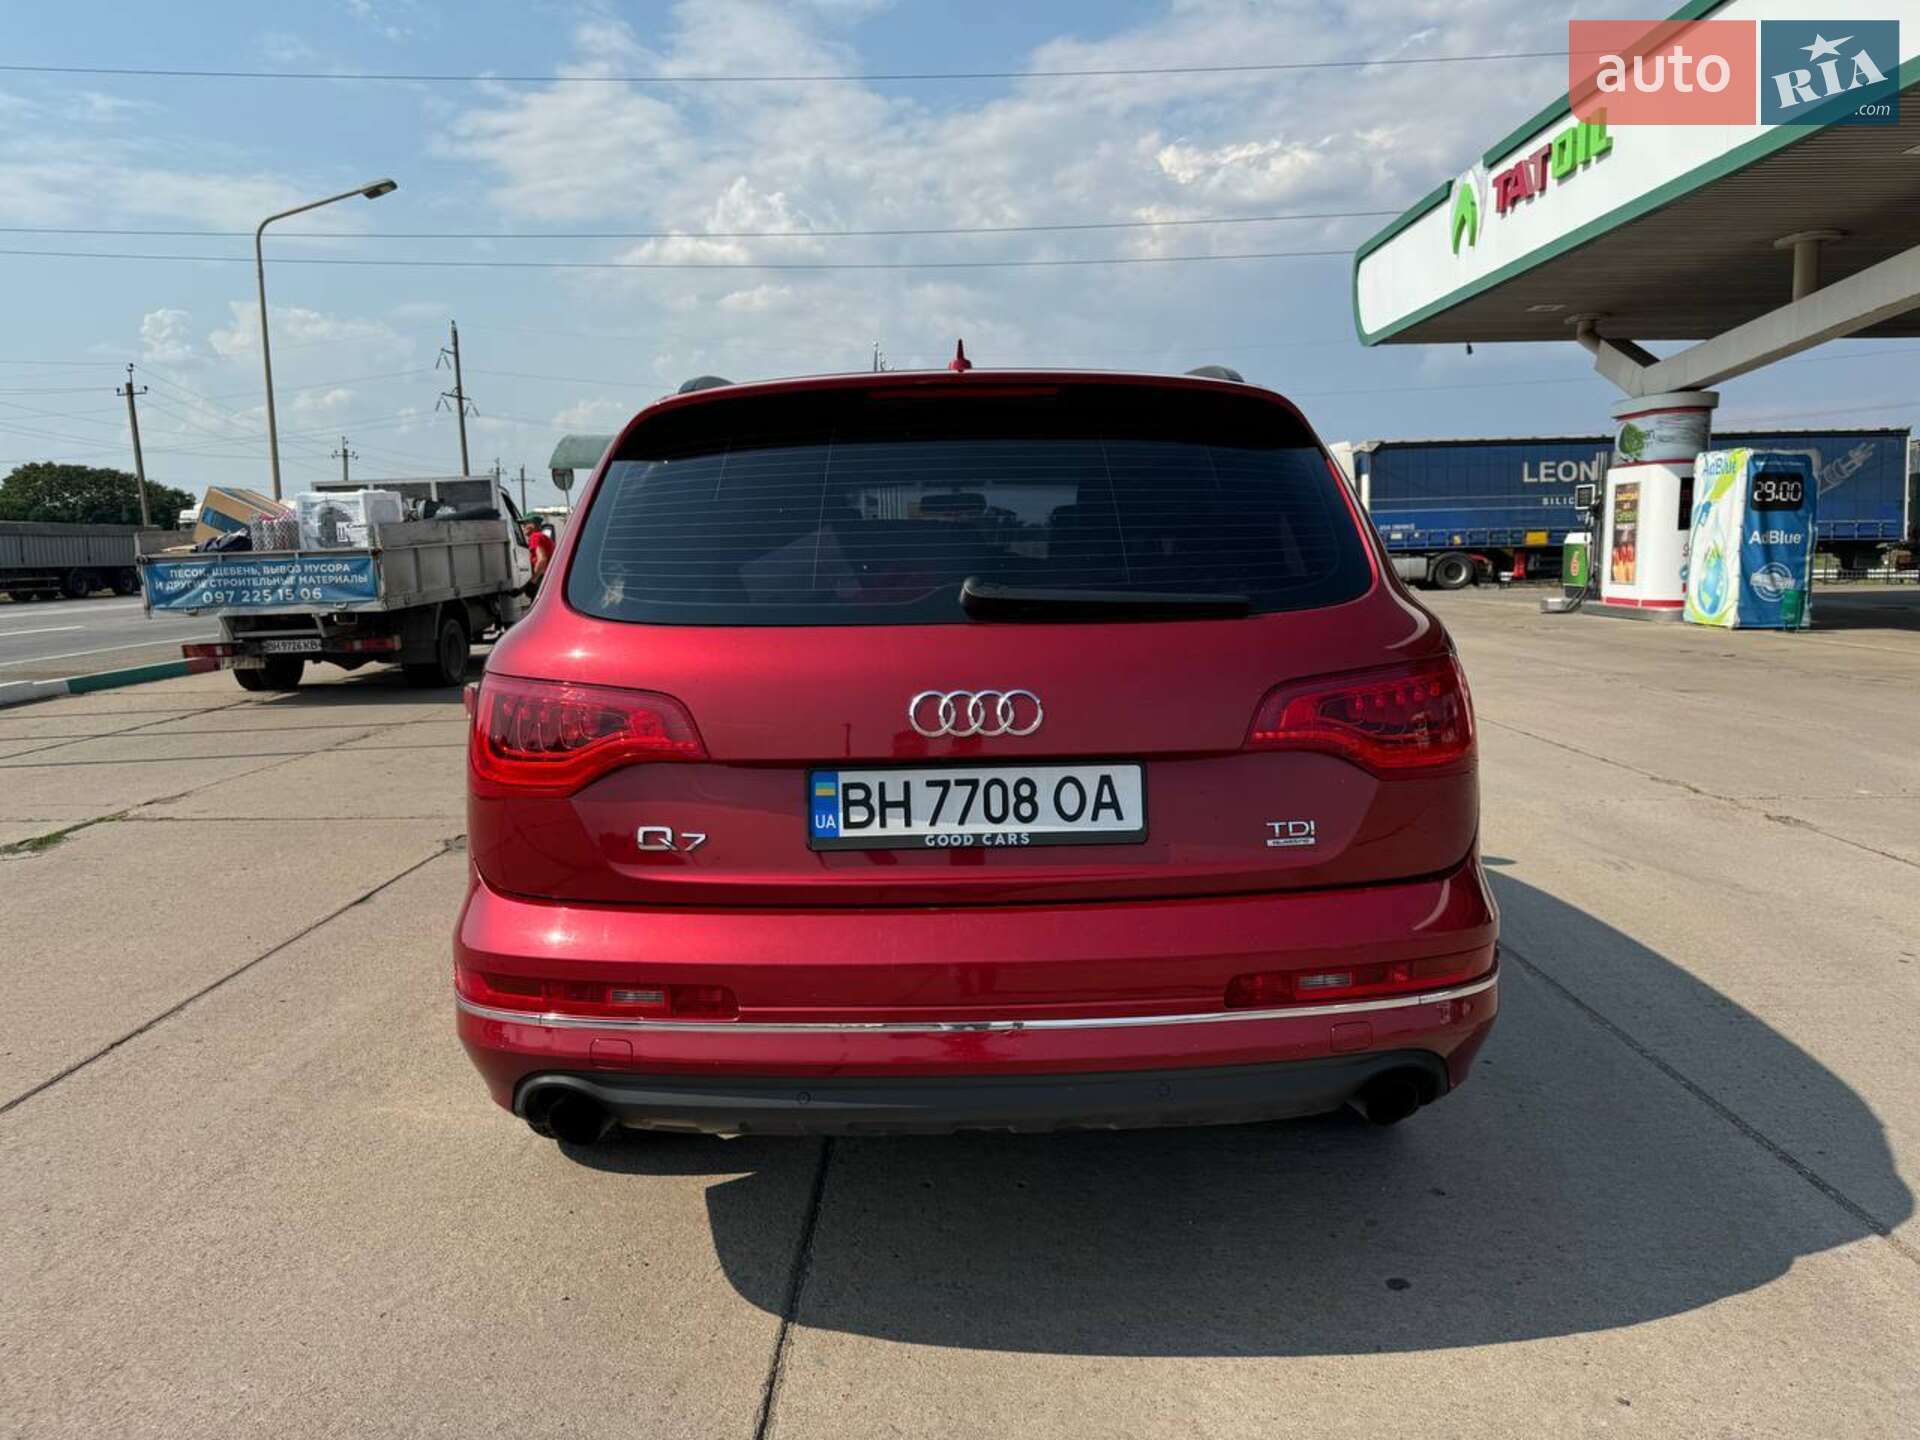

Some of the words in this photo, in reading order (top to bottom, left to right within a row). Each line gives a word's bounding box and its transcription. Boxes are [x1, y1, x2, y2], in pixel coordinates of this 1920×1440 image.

[1749, 530, 1803, 545] AdBlue
[304, 563, 351, 573] МУСОРА
[202, 590, 235, 604] 097
[241, 589, 273, 602] 225
[277, 588, 294, 601] 15
[300, 587, 322, 600] 06
[841, 780, 912, 830] BH
[925, 776, 1039, 827] 7708
[1053, 774, 1124, 823] OA
[815, 813, 837, 830] UA
[1265, 820, 1315, 837] TDI
[924, 833, 974, 846] GOOD
[982, 832, 1031, 845] CARS
